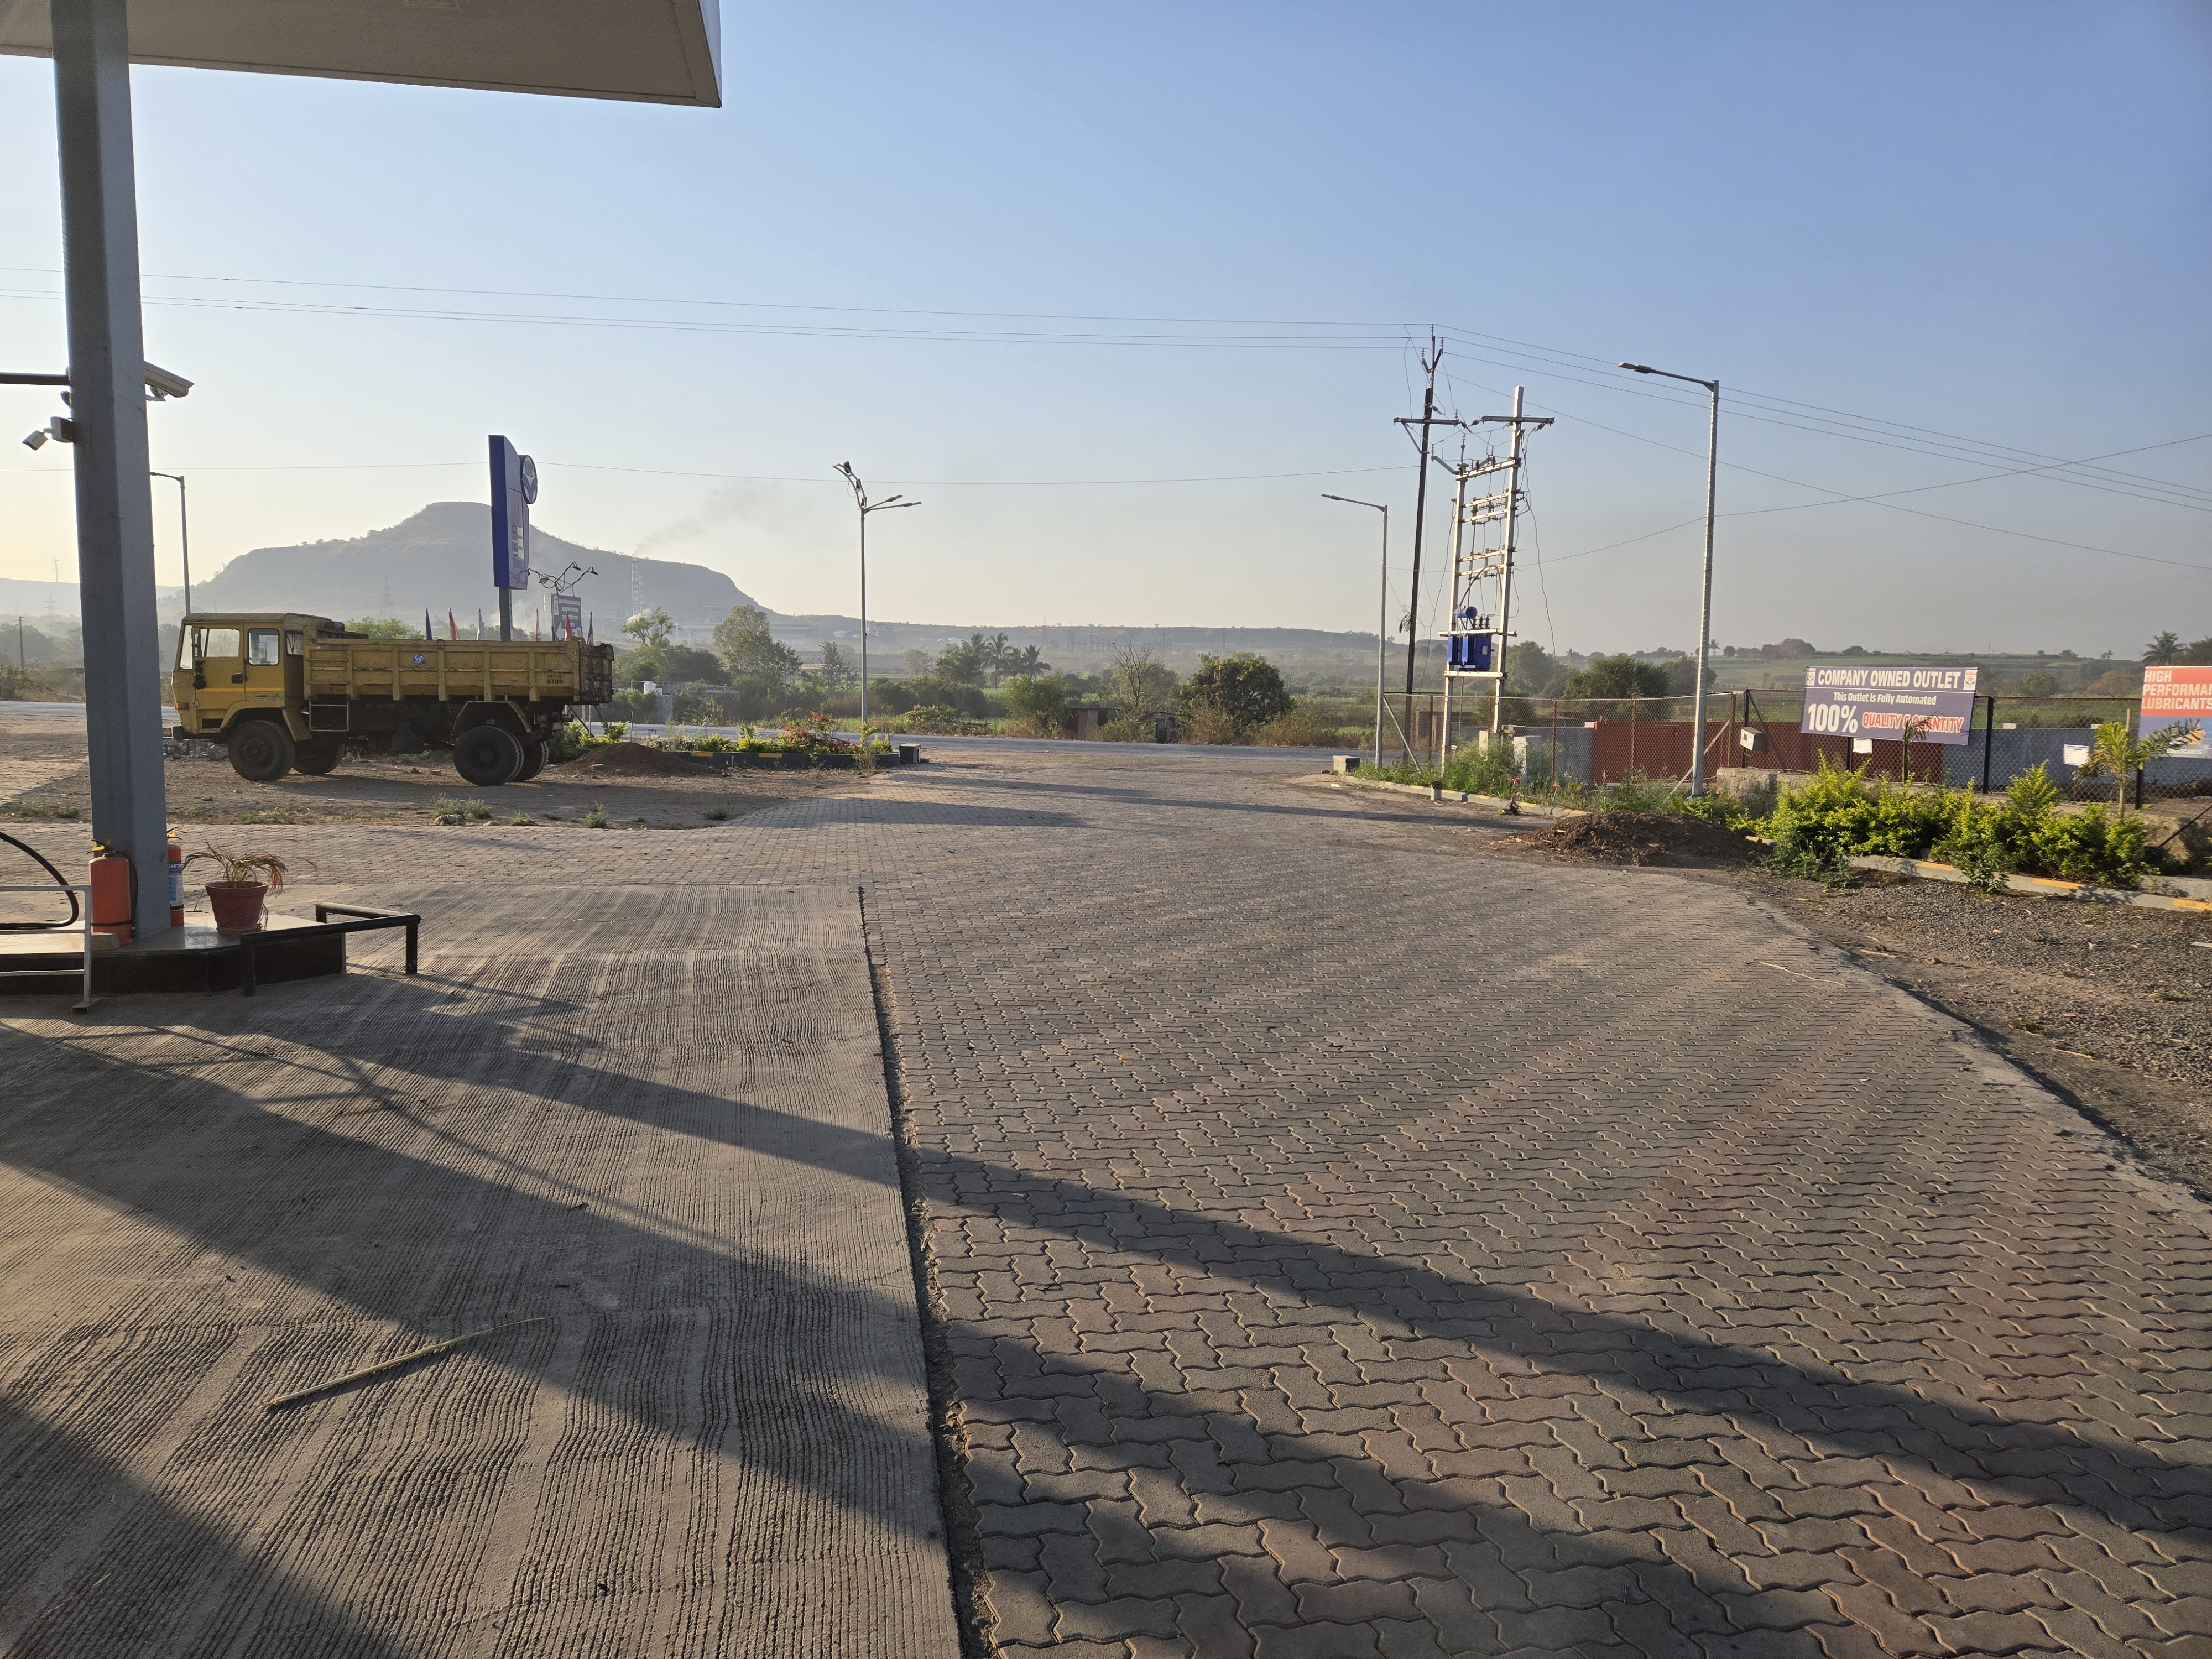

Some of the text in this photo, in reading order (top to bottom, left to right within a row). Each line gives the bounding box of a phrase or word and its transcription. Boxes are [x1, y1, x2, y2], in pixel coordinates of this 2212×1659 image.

[1818, 670, 1961, 688] COMPANY OWNED OUTLET
[2143, 670, 2172, 682] HIGH
[1834, 692, 1937, 705] This Outlet is Fully Automated
[2141, 697, 2212, 709] LUBRICANTS
[1808, 703, 1858, 733] 100%
[1862, 712, 1902, 729] QUALITY
